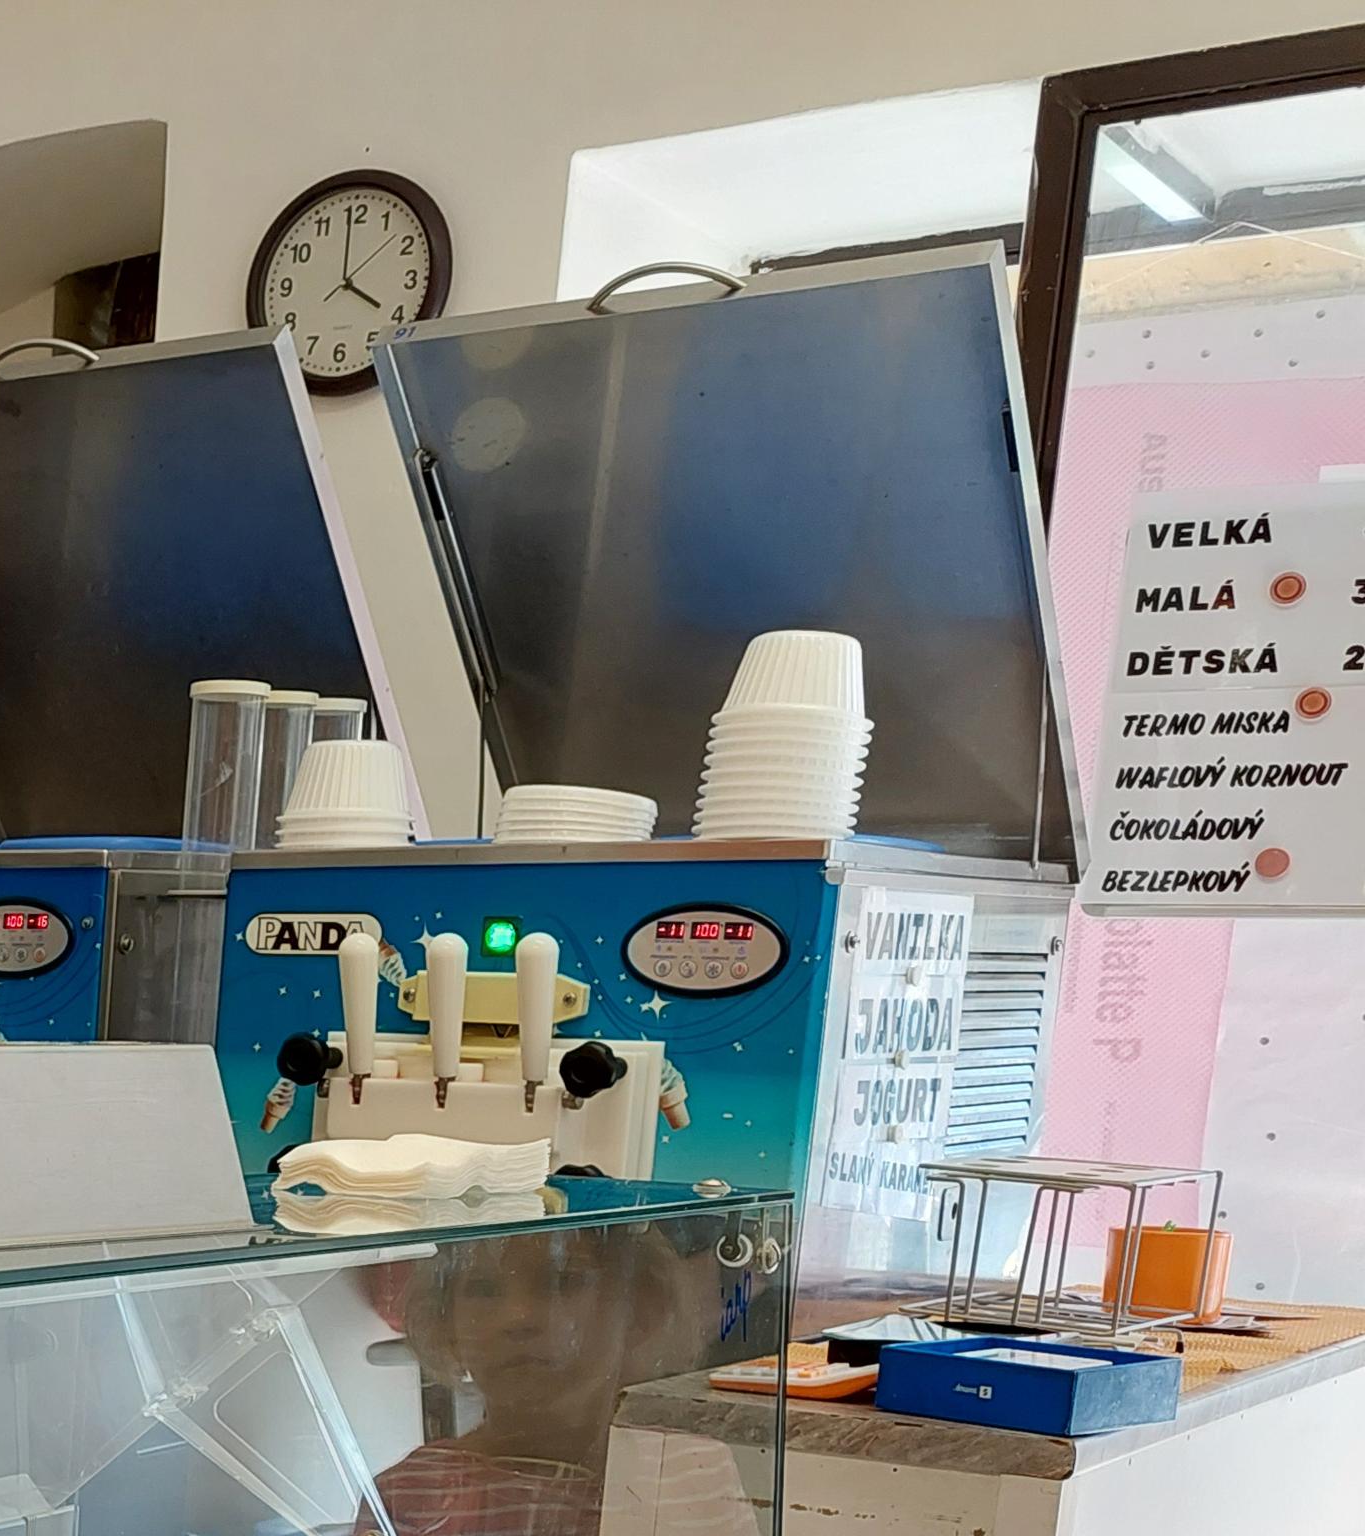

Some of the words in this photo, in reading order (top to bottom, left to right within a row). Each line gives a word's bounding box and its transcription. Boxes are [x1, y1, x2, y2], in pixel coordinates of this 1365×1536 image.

[342, 204, 369, 225] 12
[381, 210, 390, 231] 1
[314, 216, 331, 237] 11
[290, 243, 311, 263] 10
[400, 235, 414, 256] 2
[280, 277, 293, 297] 9
[403, 269, 418, 290] 3
[285, 312, 296, 332] 8
[391, 304, 405, 325] 4
[306, 336, 319, 355] 7
[333, 343, 346, 363] 6
[1147, 513, 1272, 549] VELKÁ
[1135, 579, 1237, 614] MALÁ
[1126, 643, 1279, 676] DĚTSKÁ
[1121, 714, 1207, 738] TERMO
[1210, 710, 1291, 735] MISKA
[1115, 757, 1226, 790] WAFLOVÝ
[1230, 762, 1348, 788] KORNOUT
[1109, 809, 1265, 841] ČOKOLÁDOVÝ
[1101, 862, 1251, 893] BEZLEPKOVÝ
[6, 916, 24, 928] 100
[695, 924, 719, 938] 100
[864, 912, 965, 961] VANILKA
[855, 998, 954, 1055] JAHODA
[853, 1078, 942, 1127] JOGURT
